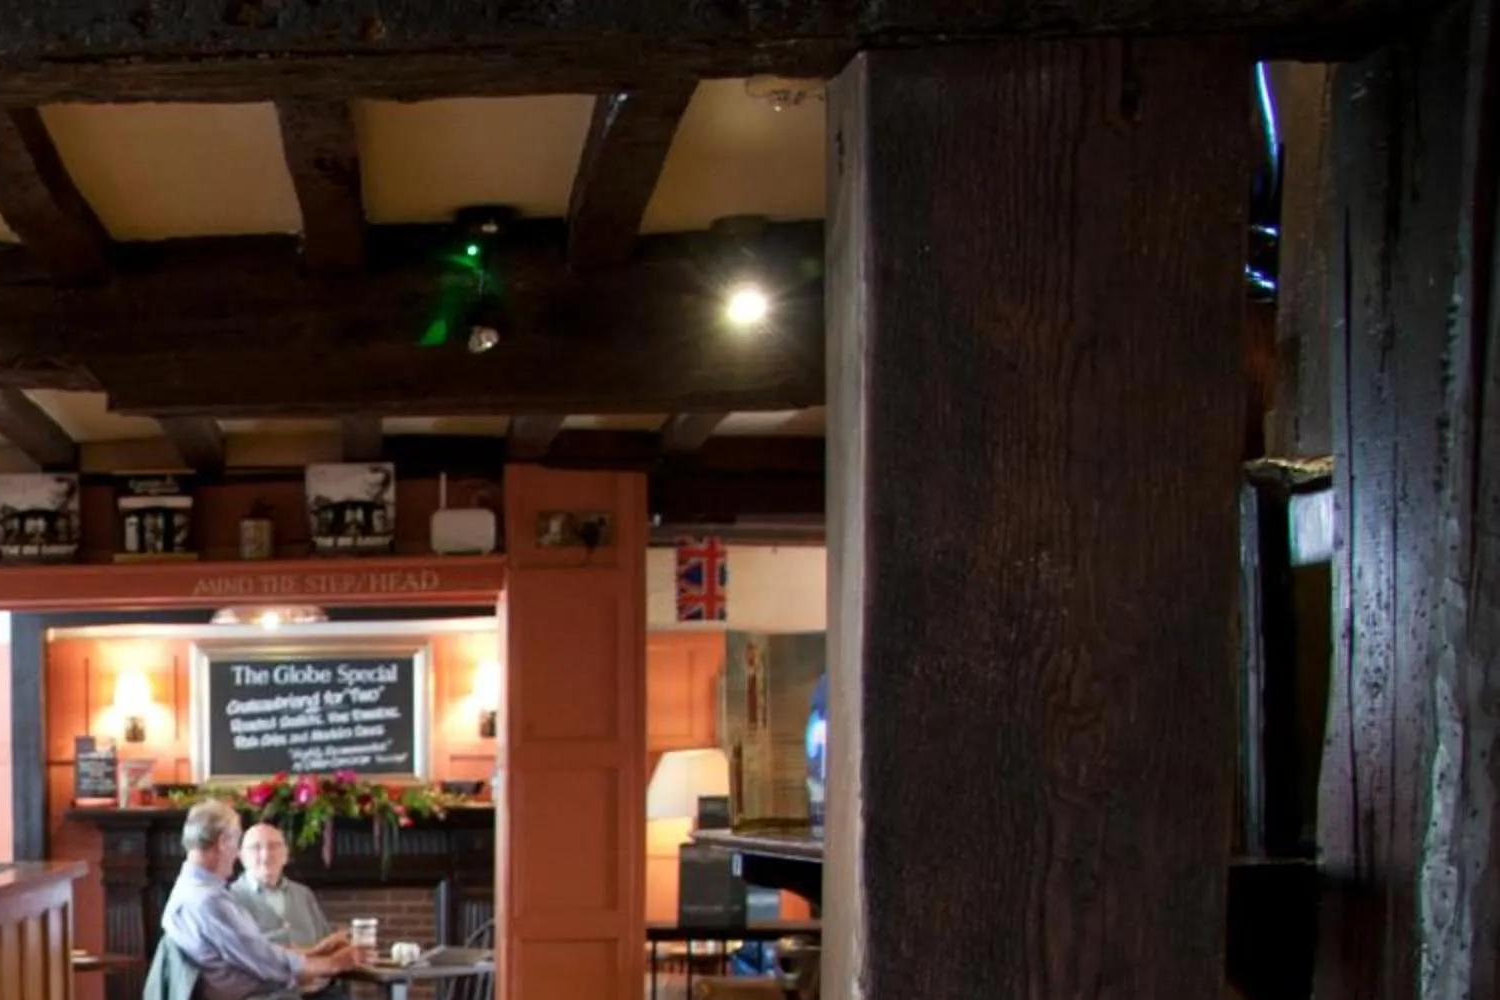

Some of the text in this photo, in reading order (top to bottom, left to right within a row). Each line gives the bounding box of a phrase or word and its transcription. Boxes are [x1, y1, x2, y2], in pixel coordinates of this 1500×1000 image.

[191, 576, 254, 596] MIND
[259, 574, 300, 594] THE
[232, 663, 398, 686] The Globe Special
